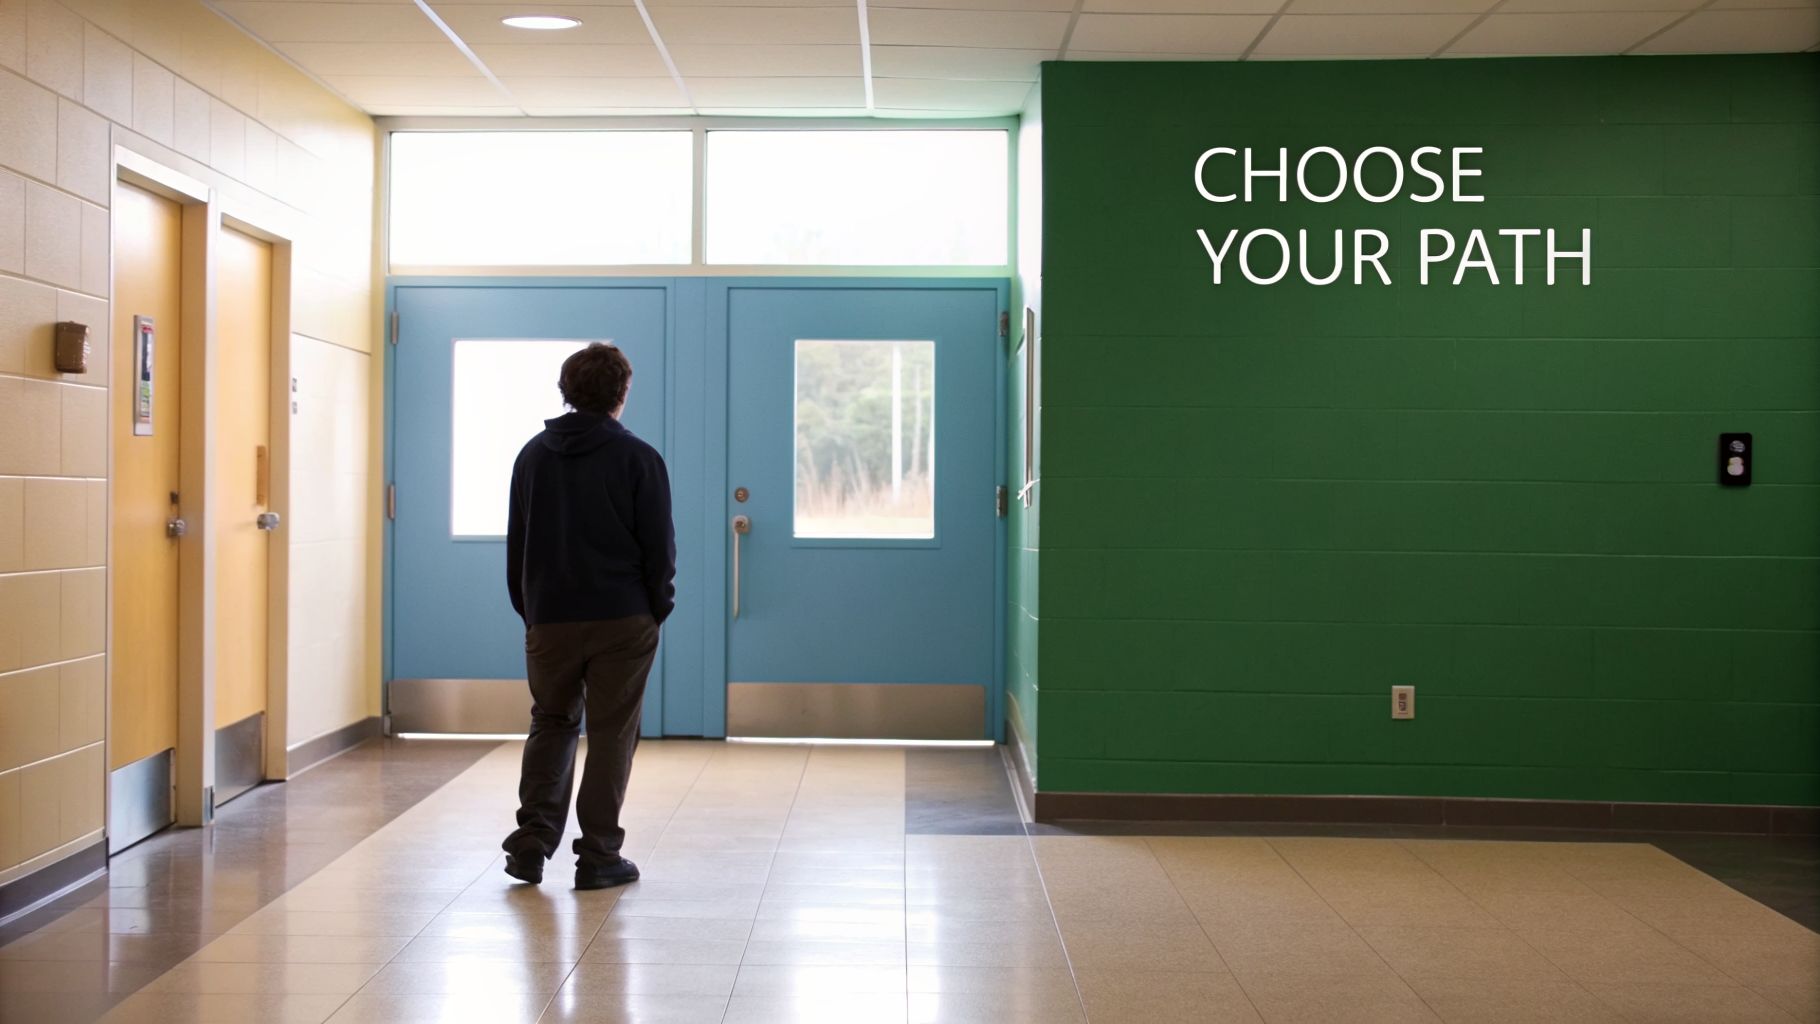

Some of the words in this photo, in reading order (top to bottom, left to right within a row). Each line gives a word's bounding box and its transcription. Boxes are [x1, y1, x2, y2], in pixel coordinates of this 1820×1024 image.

[1194, 146, 1485, 203] CHOOSE
[1196, 228, 1392, 286] YOUR
[1420, 228, 1591, 286] PATH
